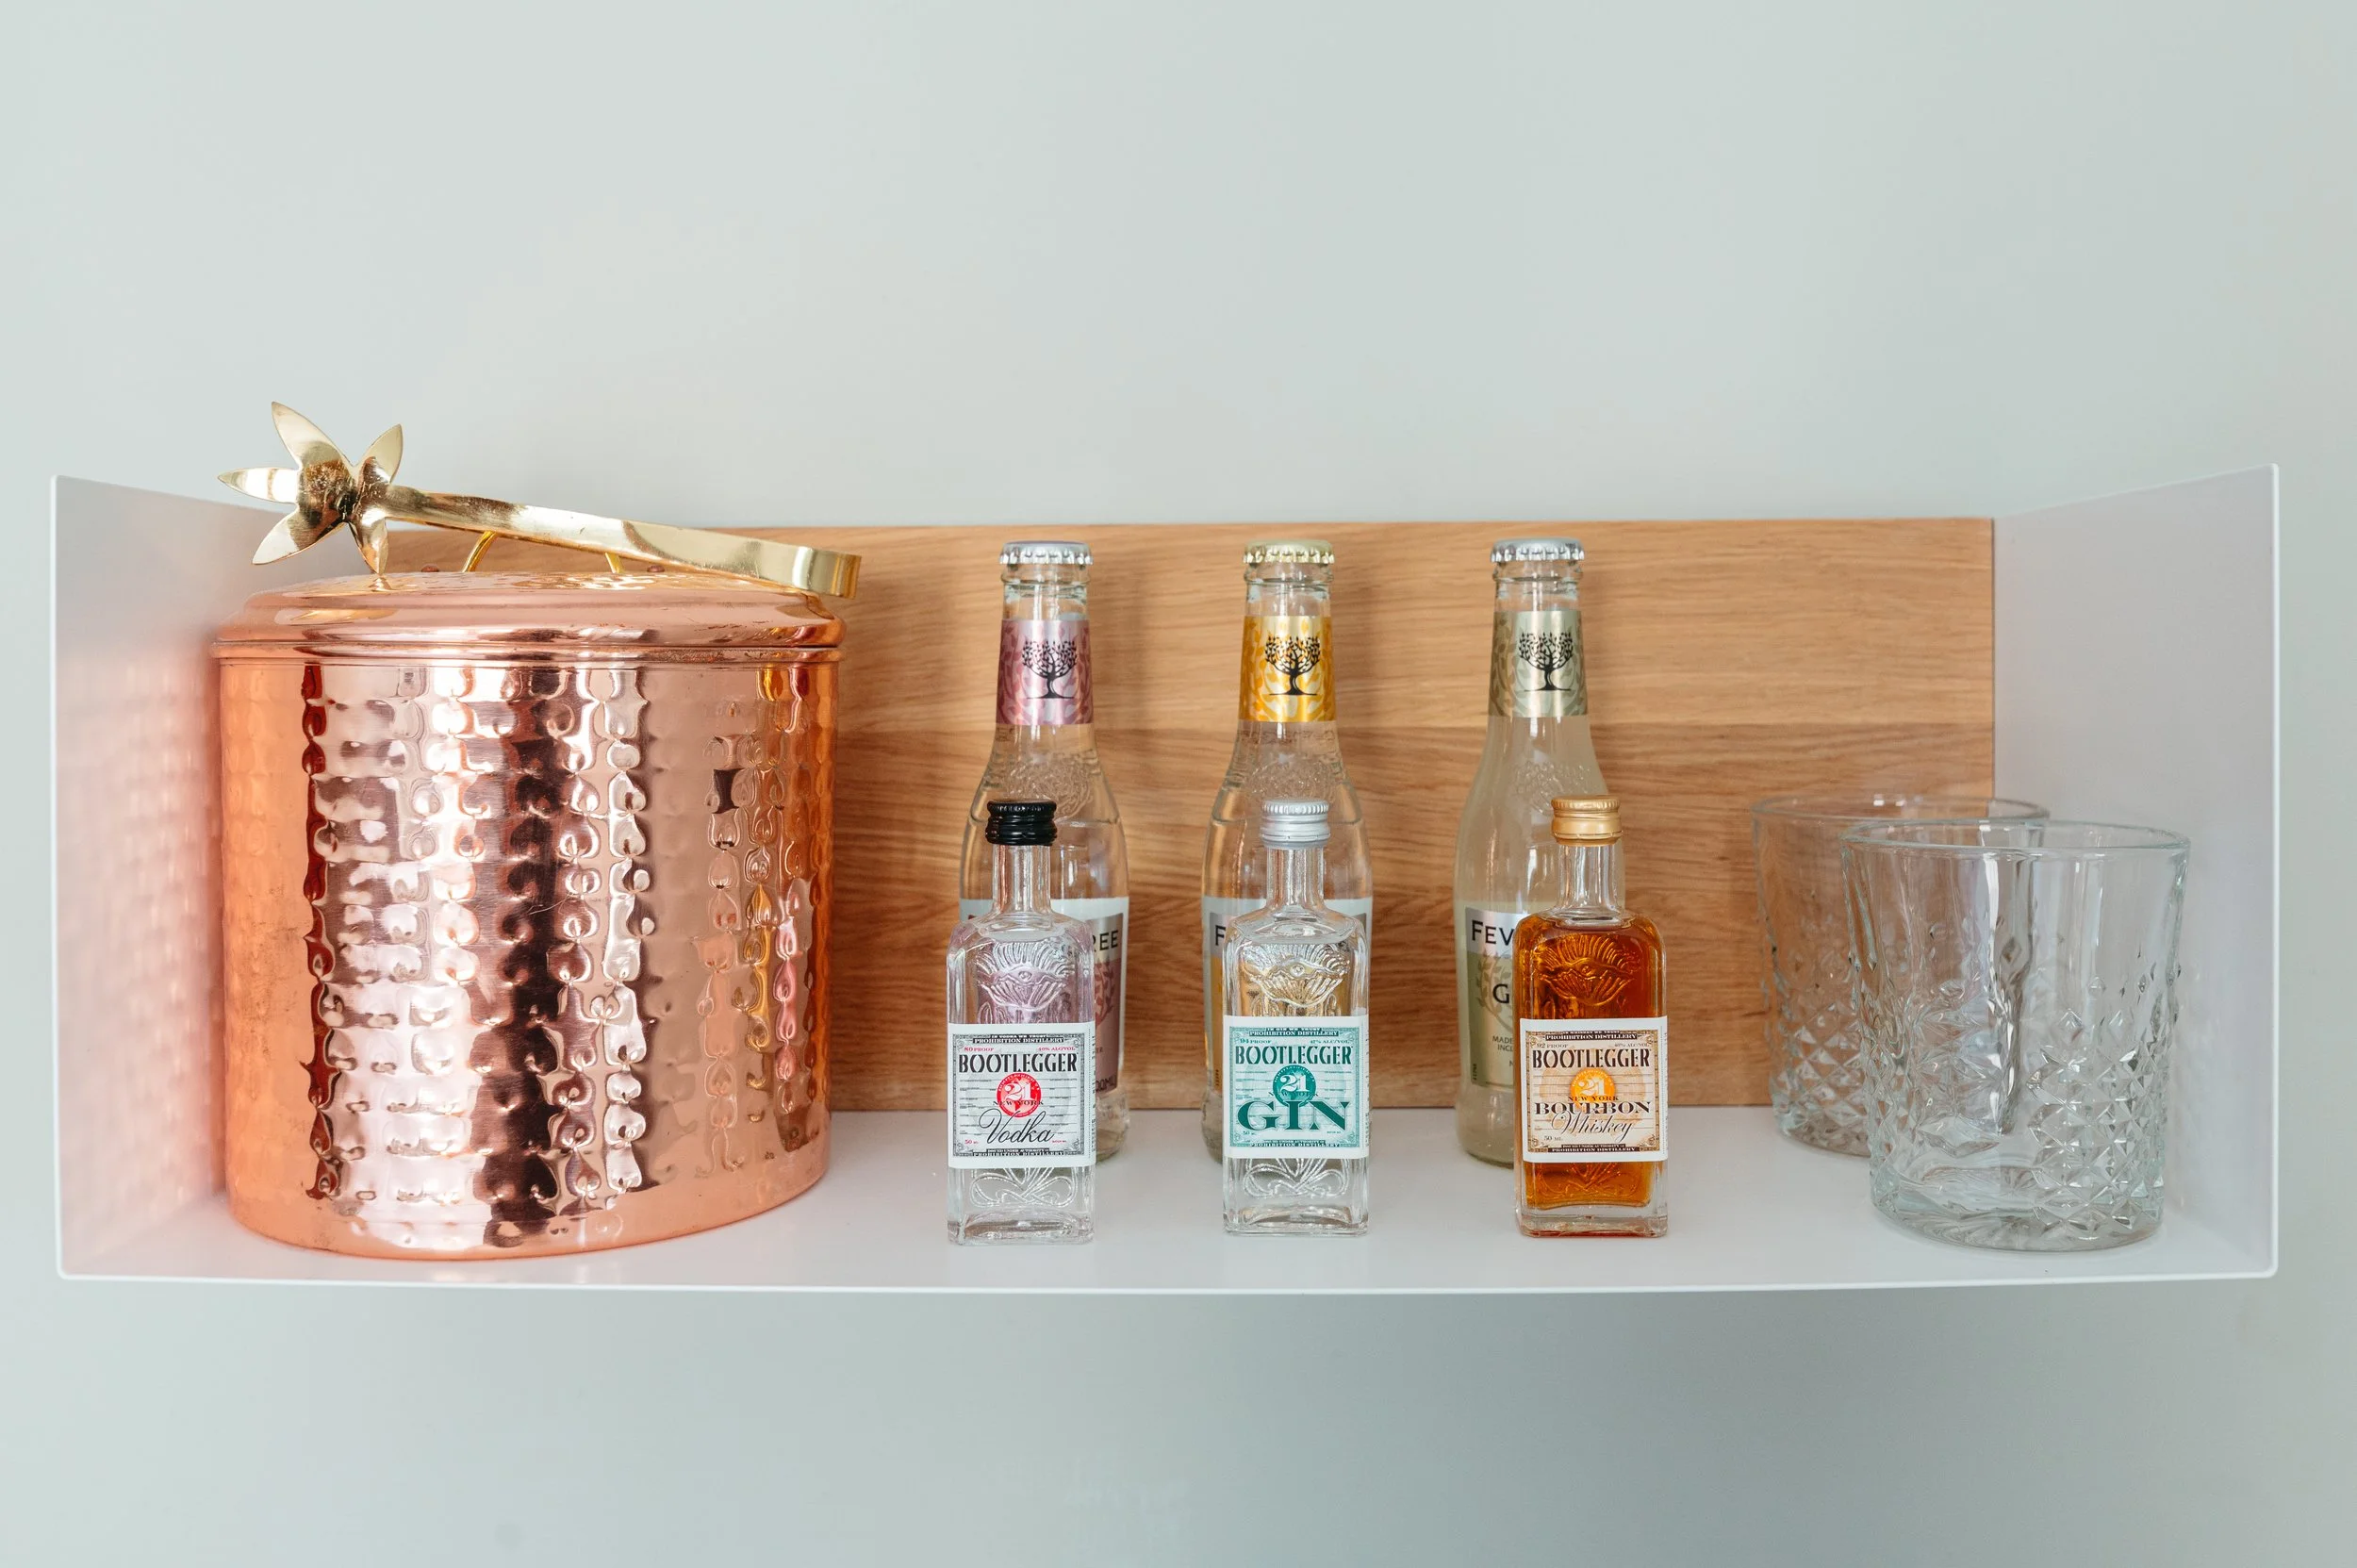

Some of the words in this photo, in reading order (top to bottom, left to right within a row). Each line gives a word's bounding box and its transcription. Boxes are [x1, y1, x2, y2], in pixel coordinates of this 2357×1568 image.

[959, 1053, 1078, 1073] BOOTLEGGER
[1235, 1046, 1352, 1065] BOOTLEGGER
[1533, 1048, 1650, 1068] BOOTLEGGER
[1004, 1082, 1035, 1101] 21
[1279, 1074, 1310, 1093] 21
[1577, 1078, 1606, 1097] 21
[1237, 1100, 1351, 1131] GIN
[1535, 1101, 1651, 1115] BOURBON
[978, 1108, 1055, 1144] Vodka
[1551, 1110, 1635, 1143] Whiskey
